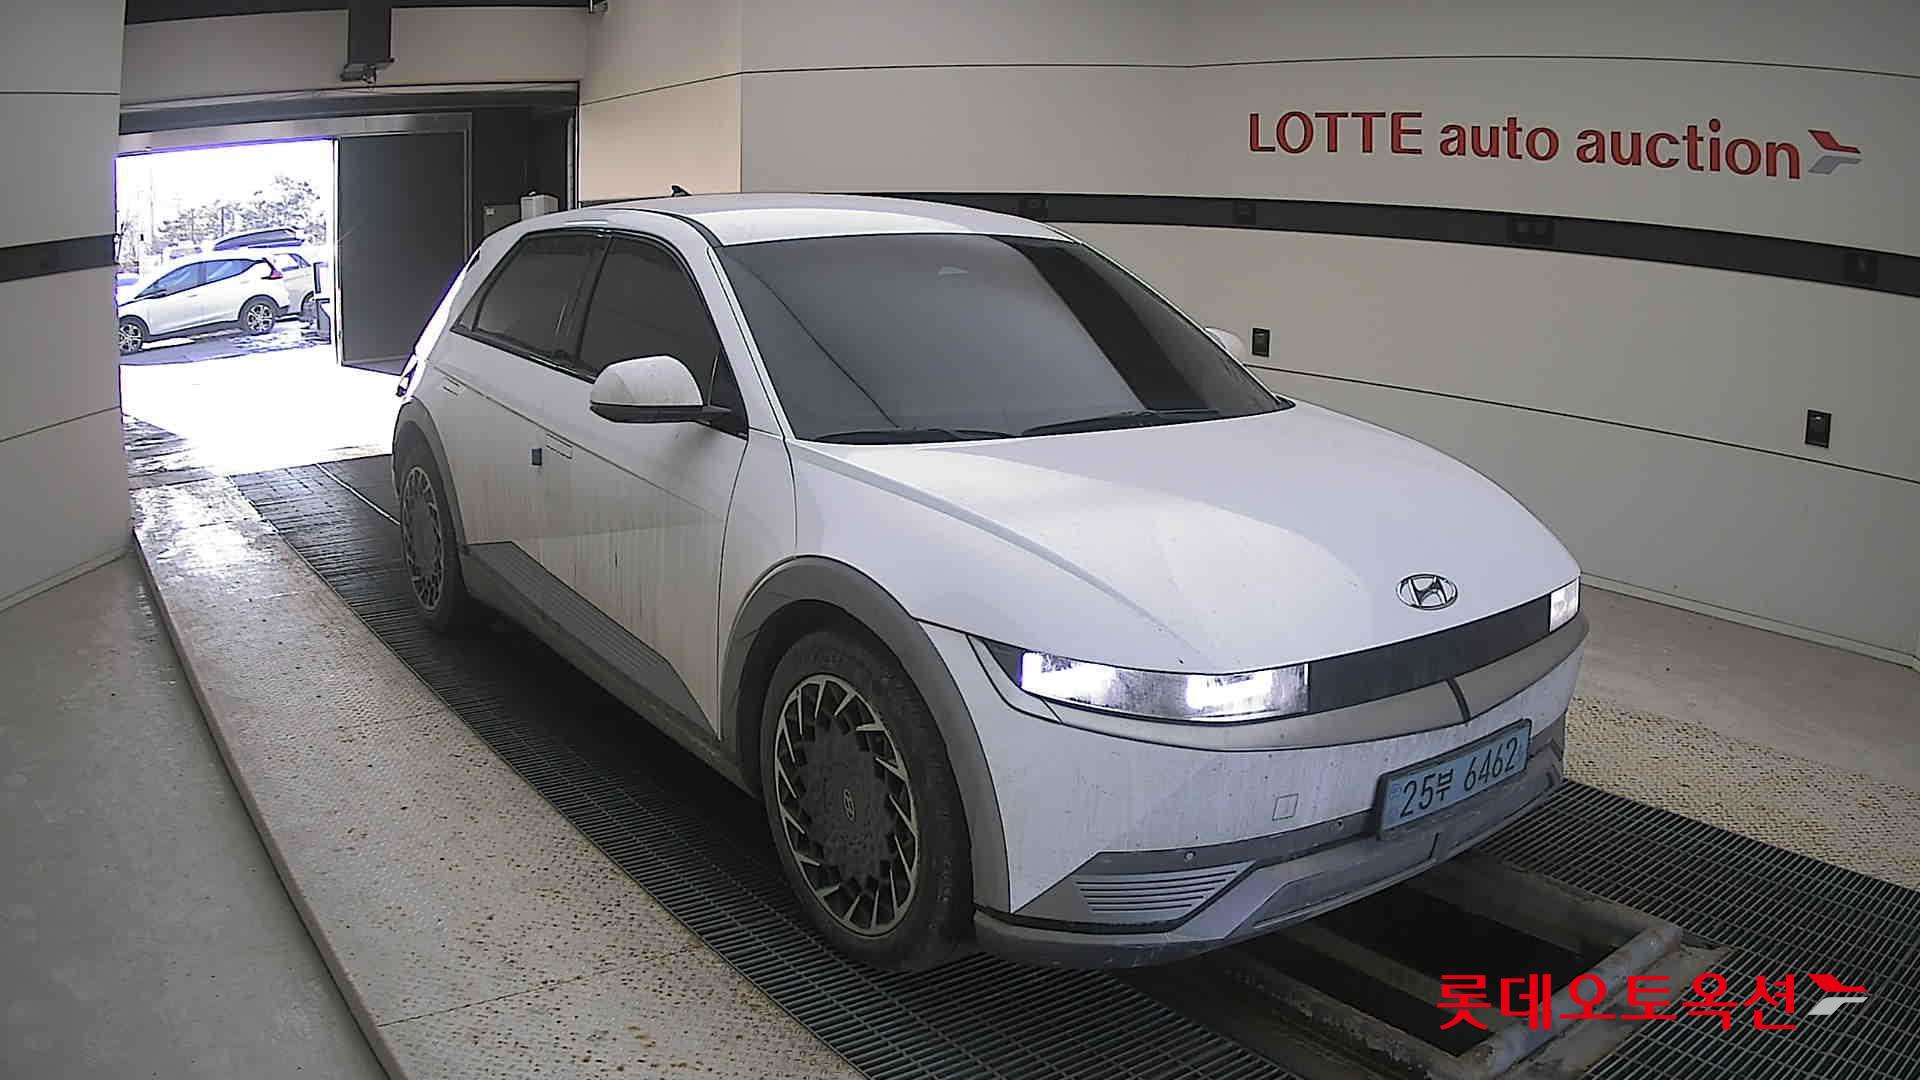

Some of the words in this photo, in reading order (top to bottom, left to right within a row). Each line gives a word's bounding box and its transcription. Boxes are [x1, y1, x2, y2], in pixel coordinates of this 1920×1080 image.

[1248, 111, 1423, 155] LOTTE
[1439, 117, 1560, 162] auto
[1576, 119, 1801, 180] auction
[1400, 768, 1454, 818] 25부
[1463, 736, 1518, 792] 6462
